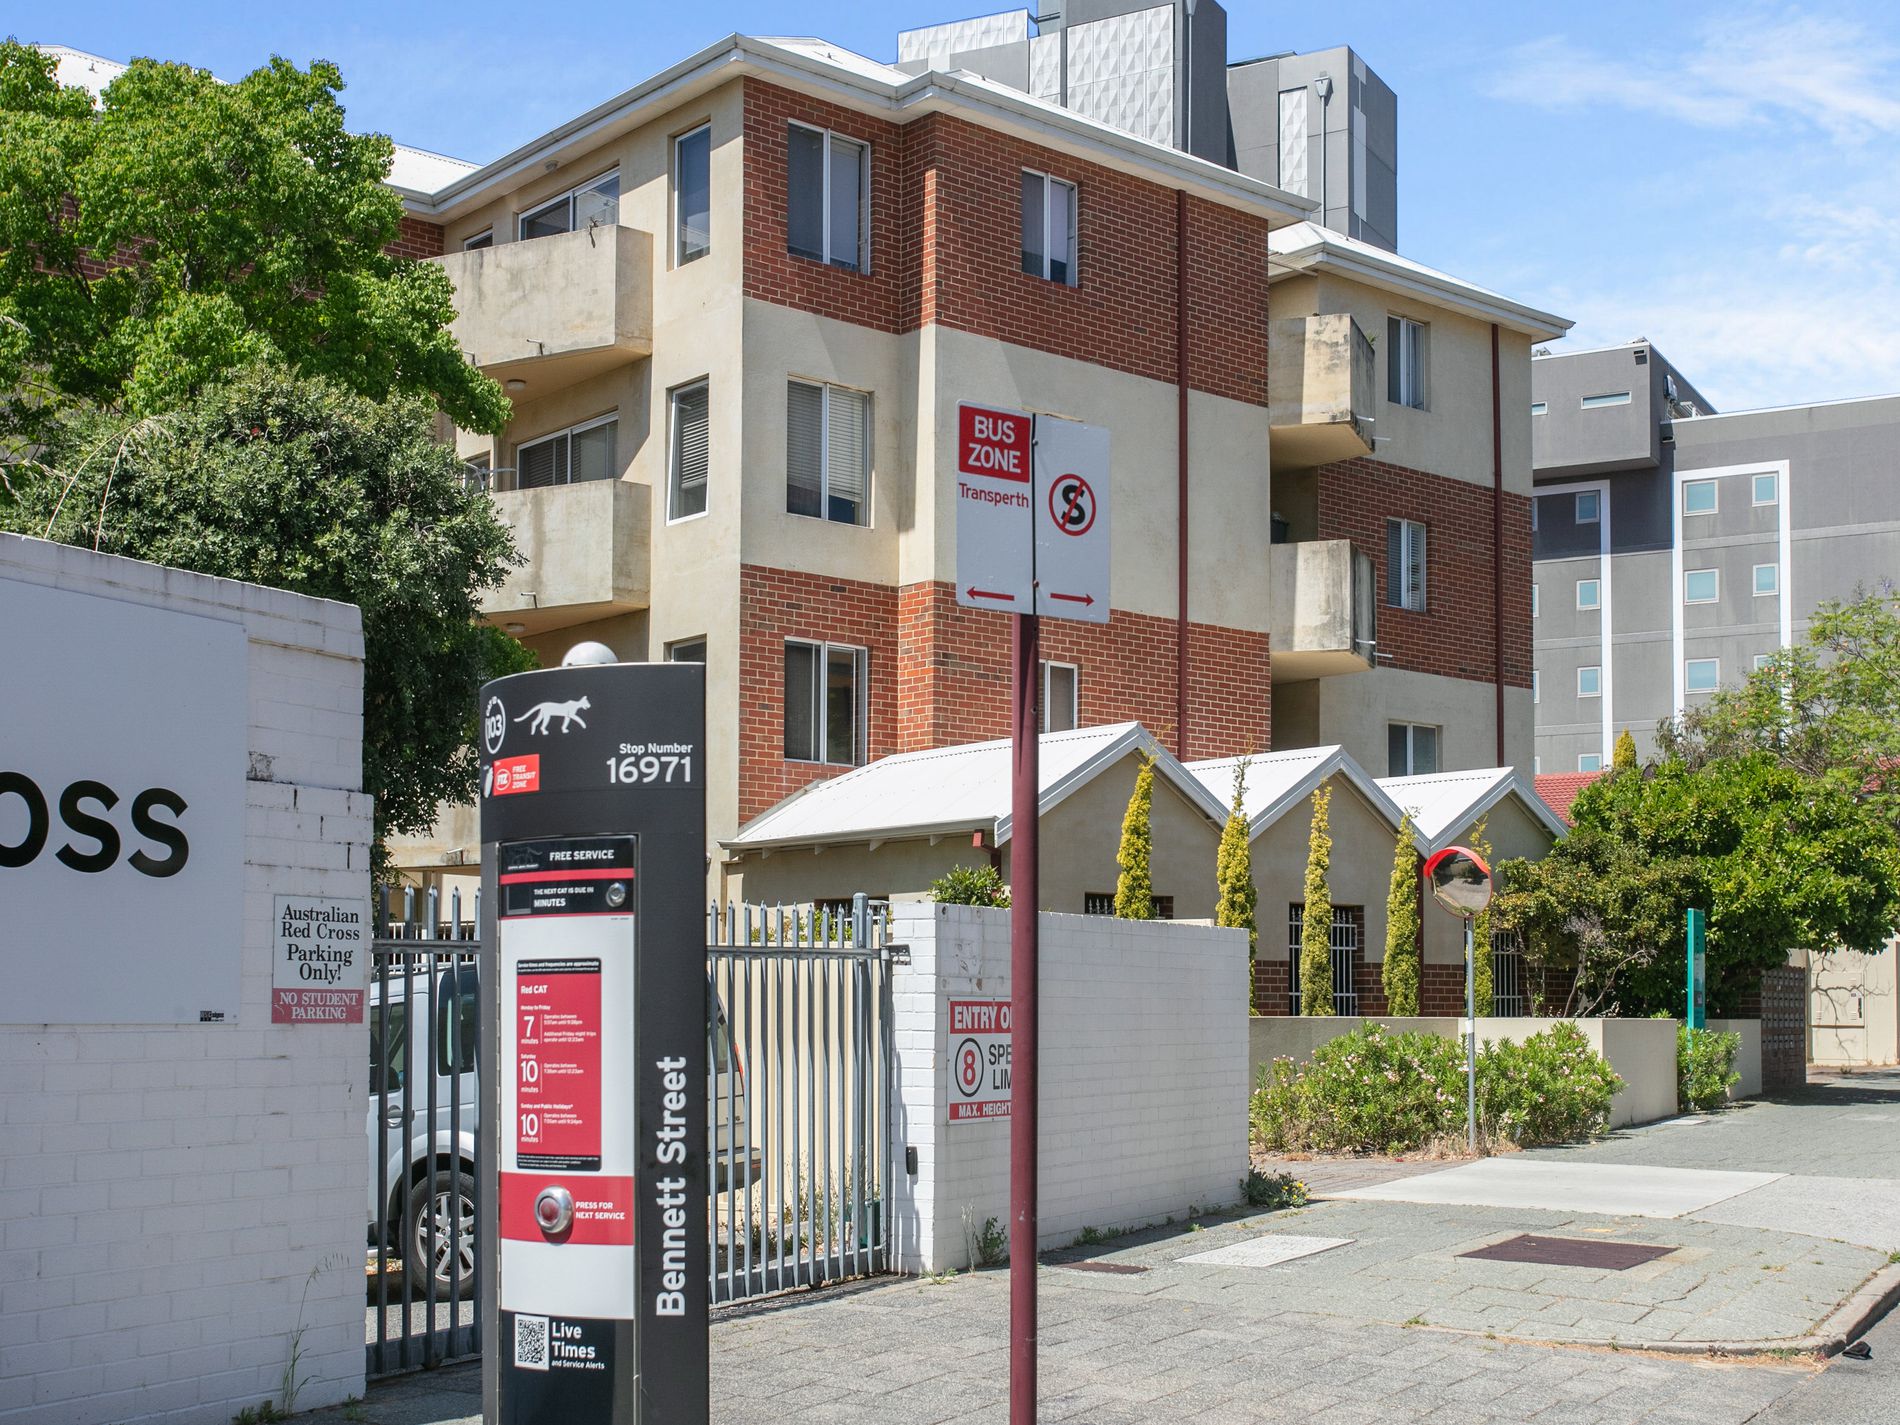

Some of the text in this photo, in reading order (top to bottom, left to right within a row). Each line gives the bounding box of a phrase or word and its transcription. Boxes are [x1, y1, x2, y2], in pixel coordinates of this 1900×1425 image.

[974, 416, 1015, 444] BUS
[968, 443, 1022, 474] ZONE
[959, 482, 1029, 508] Transperth
[1061, 484, 1086, 526] S
[487, 714, 502, 739] 103
[619, 743, 693, 755] Stop Number
[606, 756, 691, 784] 16971
[550, 849, 614, 861] FREE SERVICE
[533, 898, 566, 908] MINUTES
[282, 904, 359, 925] Australian
[282, 922, 360, 941] Red Cross
[286, 943, 354, 967] Parking
[299, 962, 342, 985] Only!
[279, 992, 358, 1006] NO STUDENT
[521, 985, 548, 994] Red CAT
[290, 1006, 347, 1020] PARKING
[954, 1005, 1012, 1030] ENTRY O
[523, 1016, 535, 1037] 7
[521, 1060, 539, 1082] 10
[962, 1049, 976, 1086] 8
[958, 1103, 1012, 1118] MAX. HEIGHT
[521, 1113, 539, 1136] 10
[656, 1056, 686, 1316] Bennett Street
[552, 1322, 582, 1339] Live
[551, 1341, 596, 1358] Times
[563, 1360, 584, 1368] Service
[586, 1361, 605, 1370] Alerts
